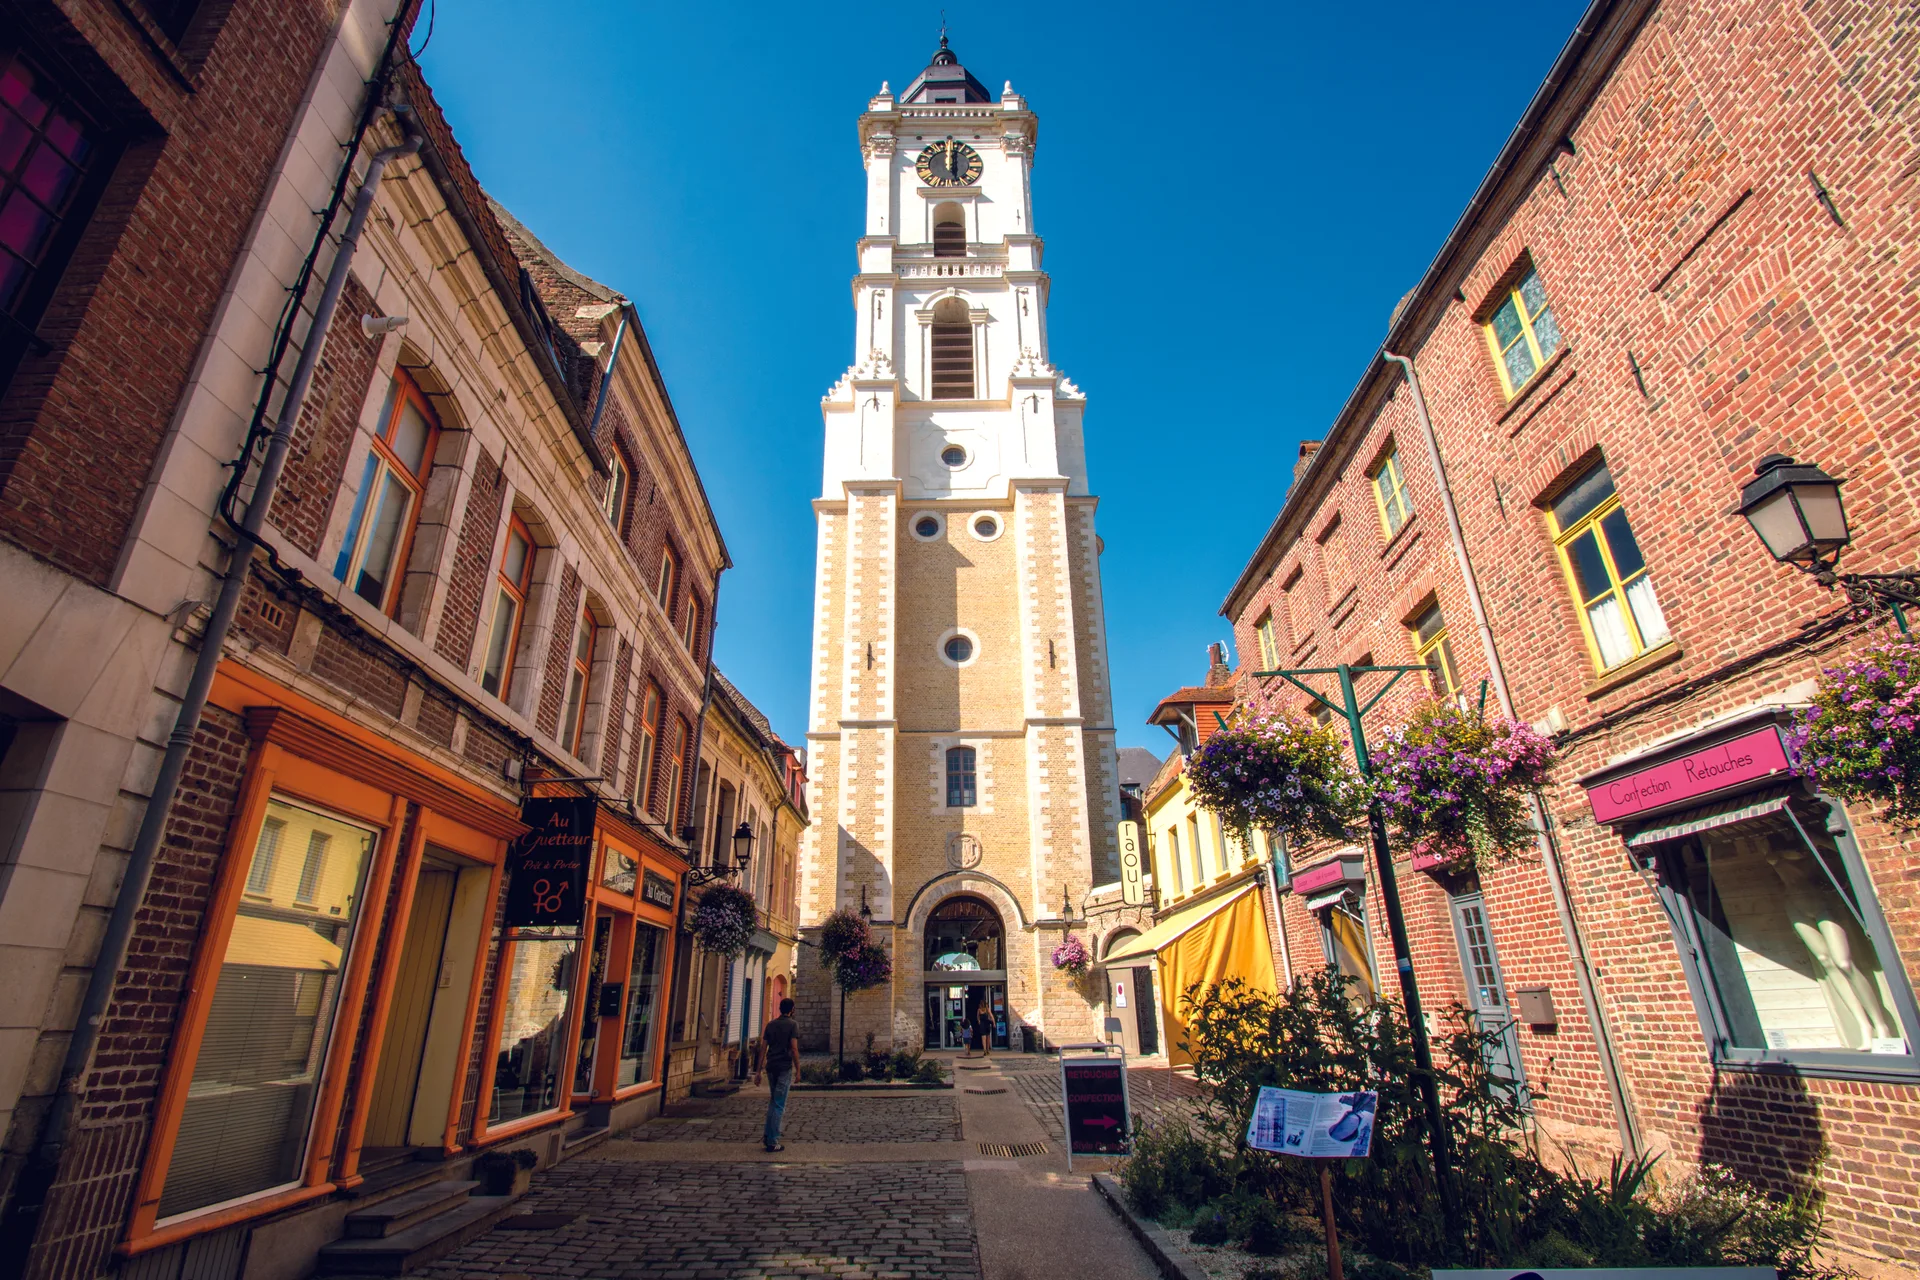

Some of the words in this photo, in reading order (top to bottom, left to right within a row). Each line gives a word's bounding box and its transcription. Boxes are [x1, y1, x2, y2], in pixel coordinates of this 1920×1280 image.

[1609, 777, 1672, 808] Confection
[1683, 747, 1753, 783] Retouches
[548, 812, 569, 828] Au
[519, 827, 591, 857] Guetteur
[553, 859, 581, 870] Porter
[646, 882, 653, 899] Au
[653, 884, 672, 906] Guetteur
[1067, 1070, 1119, 1079] RETOUCHES
[1068, 1094, 1123, 1103] CONFECTION
